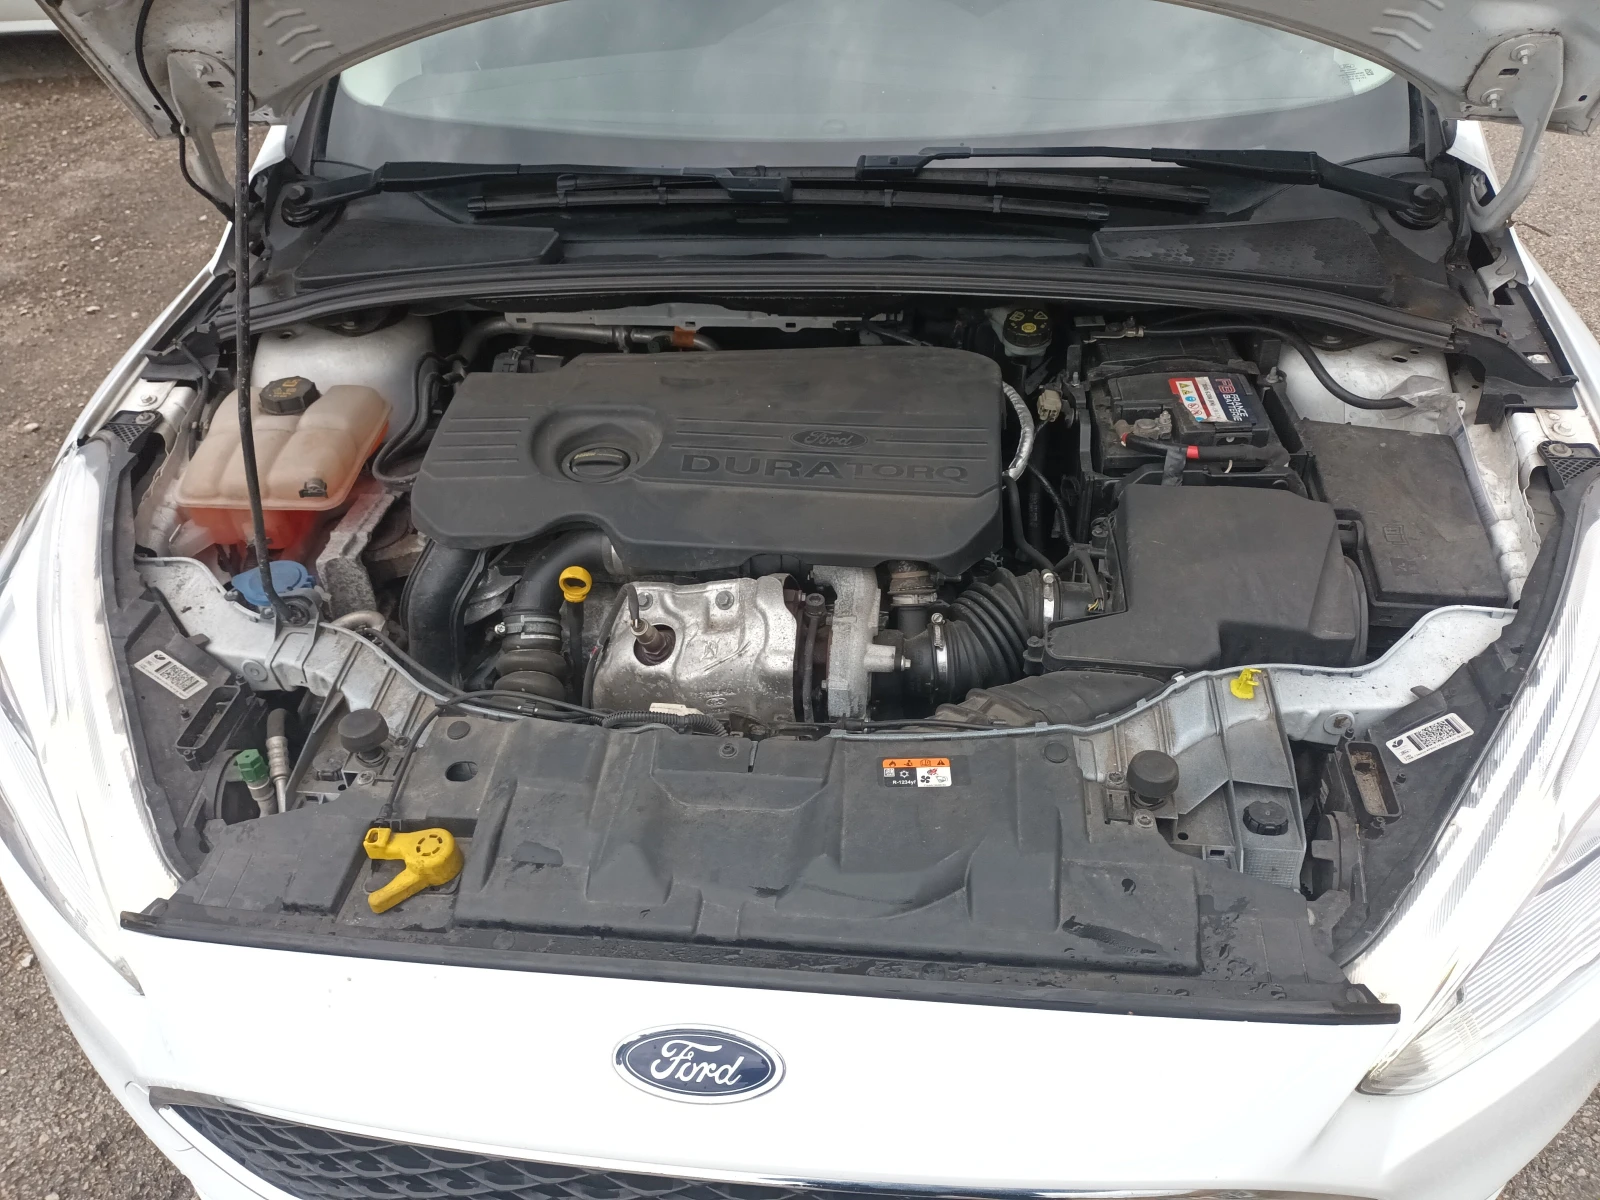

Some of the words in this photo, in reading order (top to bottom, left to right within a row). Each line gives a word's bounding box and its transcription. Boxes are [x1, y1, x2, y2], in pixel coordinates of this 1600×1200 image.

[1222, 394, 1243, 422] BATTERIE
[1230, 394, 1249, 418] FRANCE
[803, 429, 855, 448] Ford
[681, 454, 969, 484] DURATORQ
[650, 1039, 745, 1086] Ford
